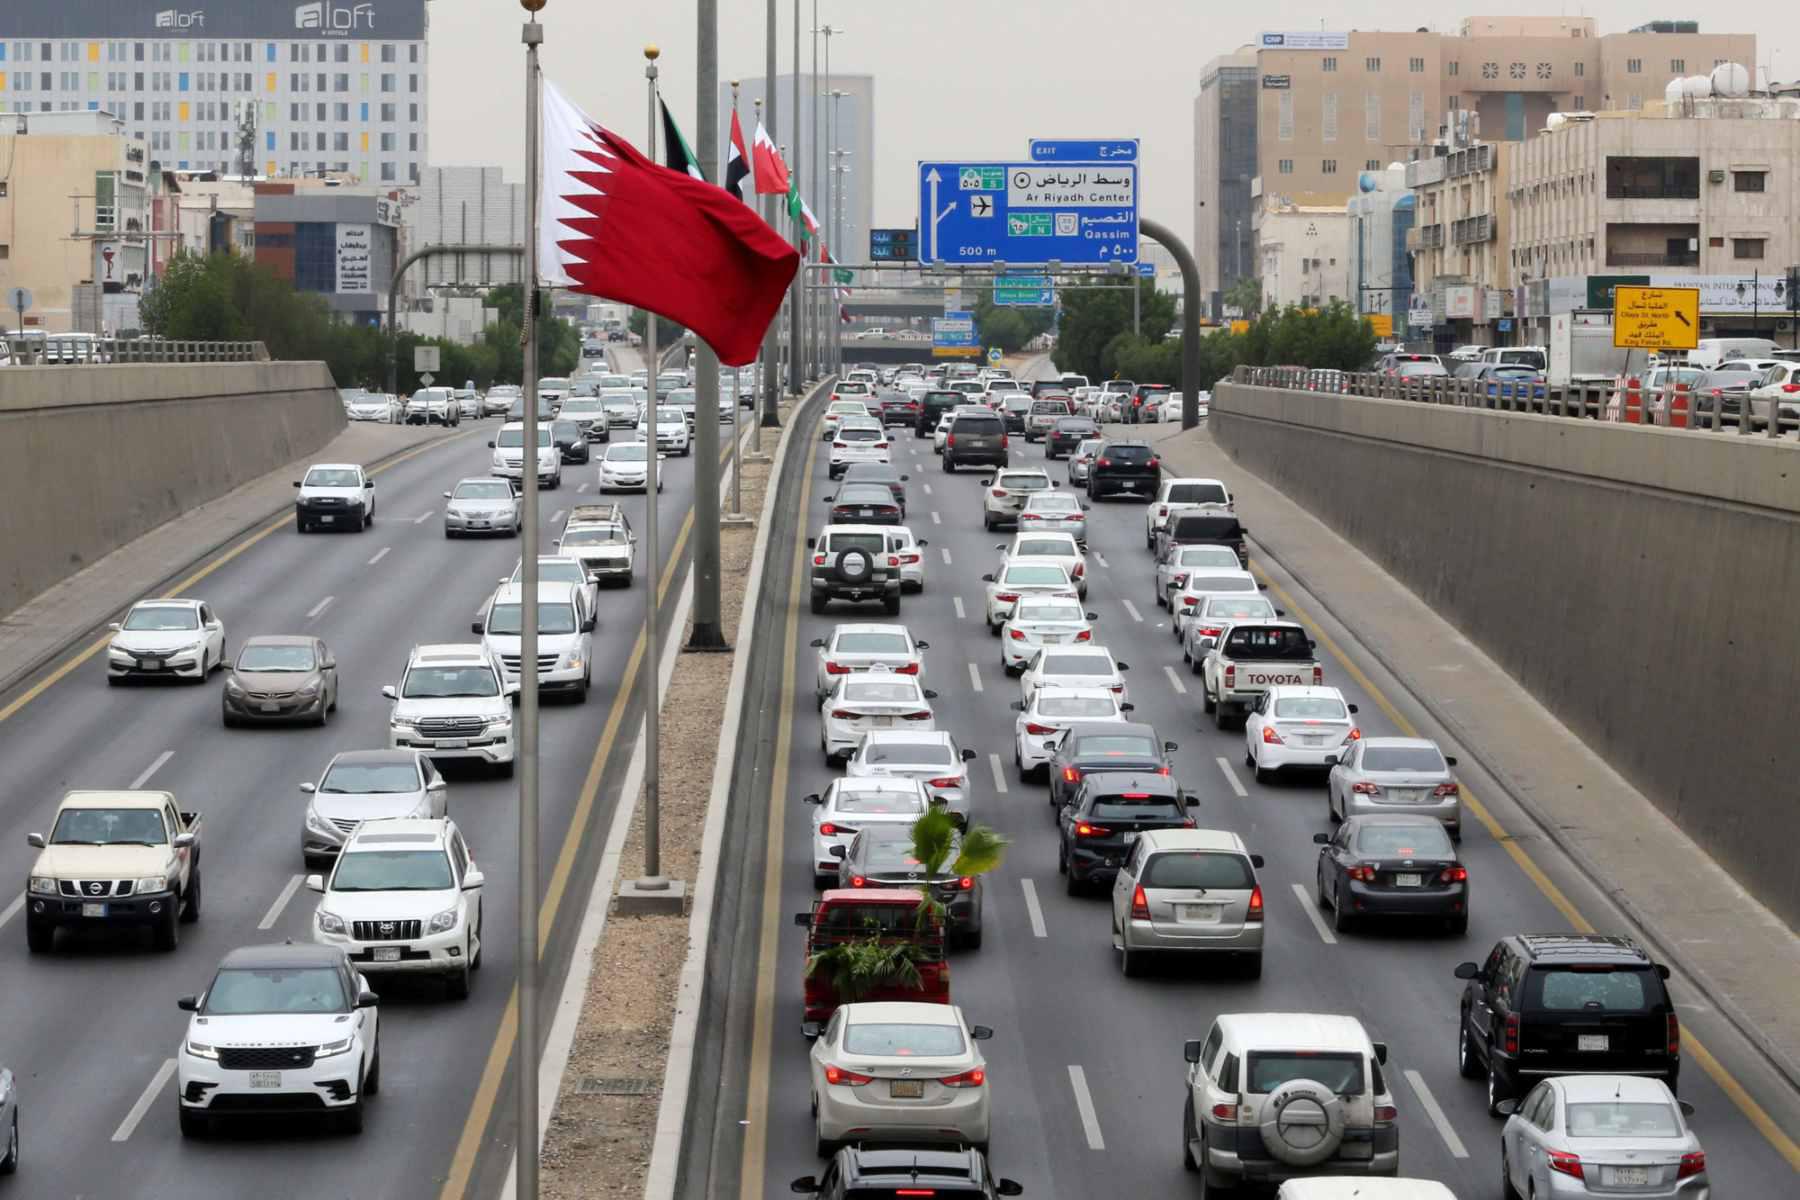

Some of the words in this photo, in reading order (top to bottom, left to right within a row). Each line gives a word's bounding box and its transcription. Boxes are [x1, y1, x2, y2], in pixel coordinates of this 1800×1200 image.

[1036, 147, 1056, 155] EXIT
[1036, 172, 1087, 188] الرياض
[1092, 171, 1130, 188] وسط
[1026, 193, 1039, 202] Ar
[1045, 192, 1085, 204] Riyadh
[1089, 193, 1131, 202] Center
[1081, 211, 1134, 227] القصيم
[1084, 229, 1130, 239] Qassim
[960, 246, 982, 256] 500
[987, 248, 997, 256] m
[1248, 674, 1302, 685] TOYOTA
